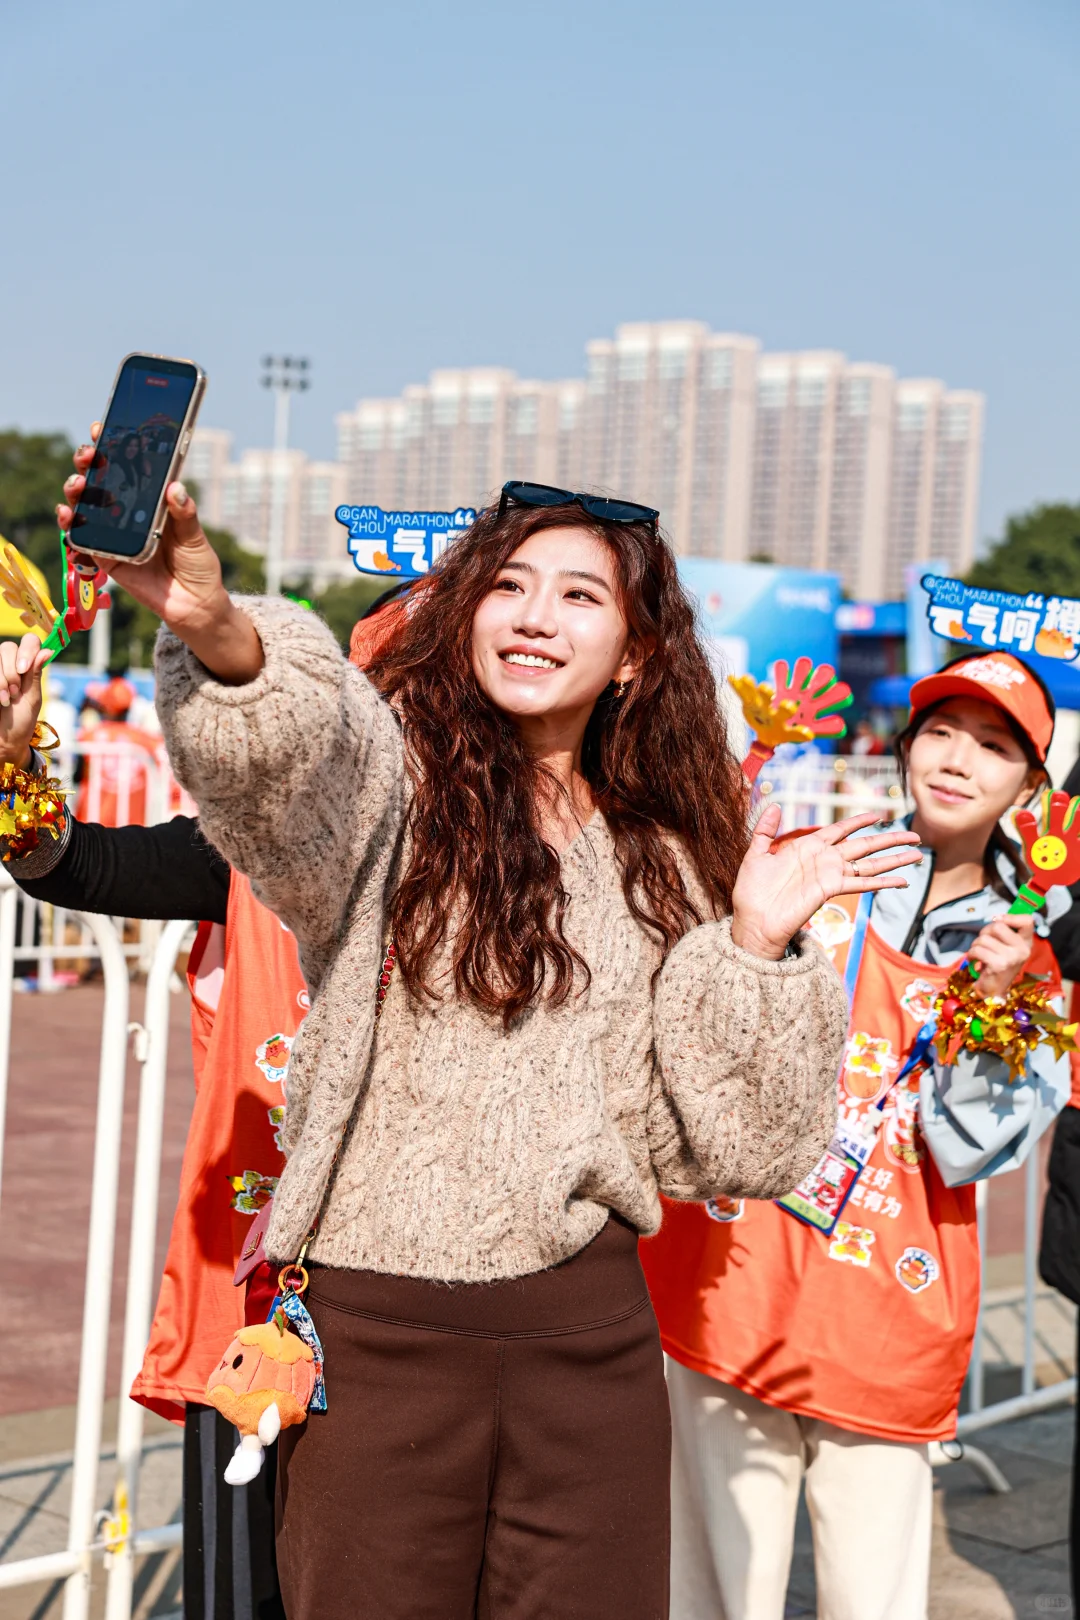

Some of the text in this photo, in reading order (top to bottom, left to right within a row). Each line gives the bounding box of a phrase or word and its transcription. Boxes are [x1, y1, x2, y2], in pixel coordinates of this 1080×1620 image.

[337, 506, 378, 521] @GAN
[351, 514, 454, 534] ZHOU MARATHON
[924, 577, 960, 592] @GAN
[932, 588, 1025, 609] ZHOU MARATHON
